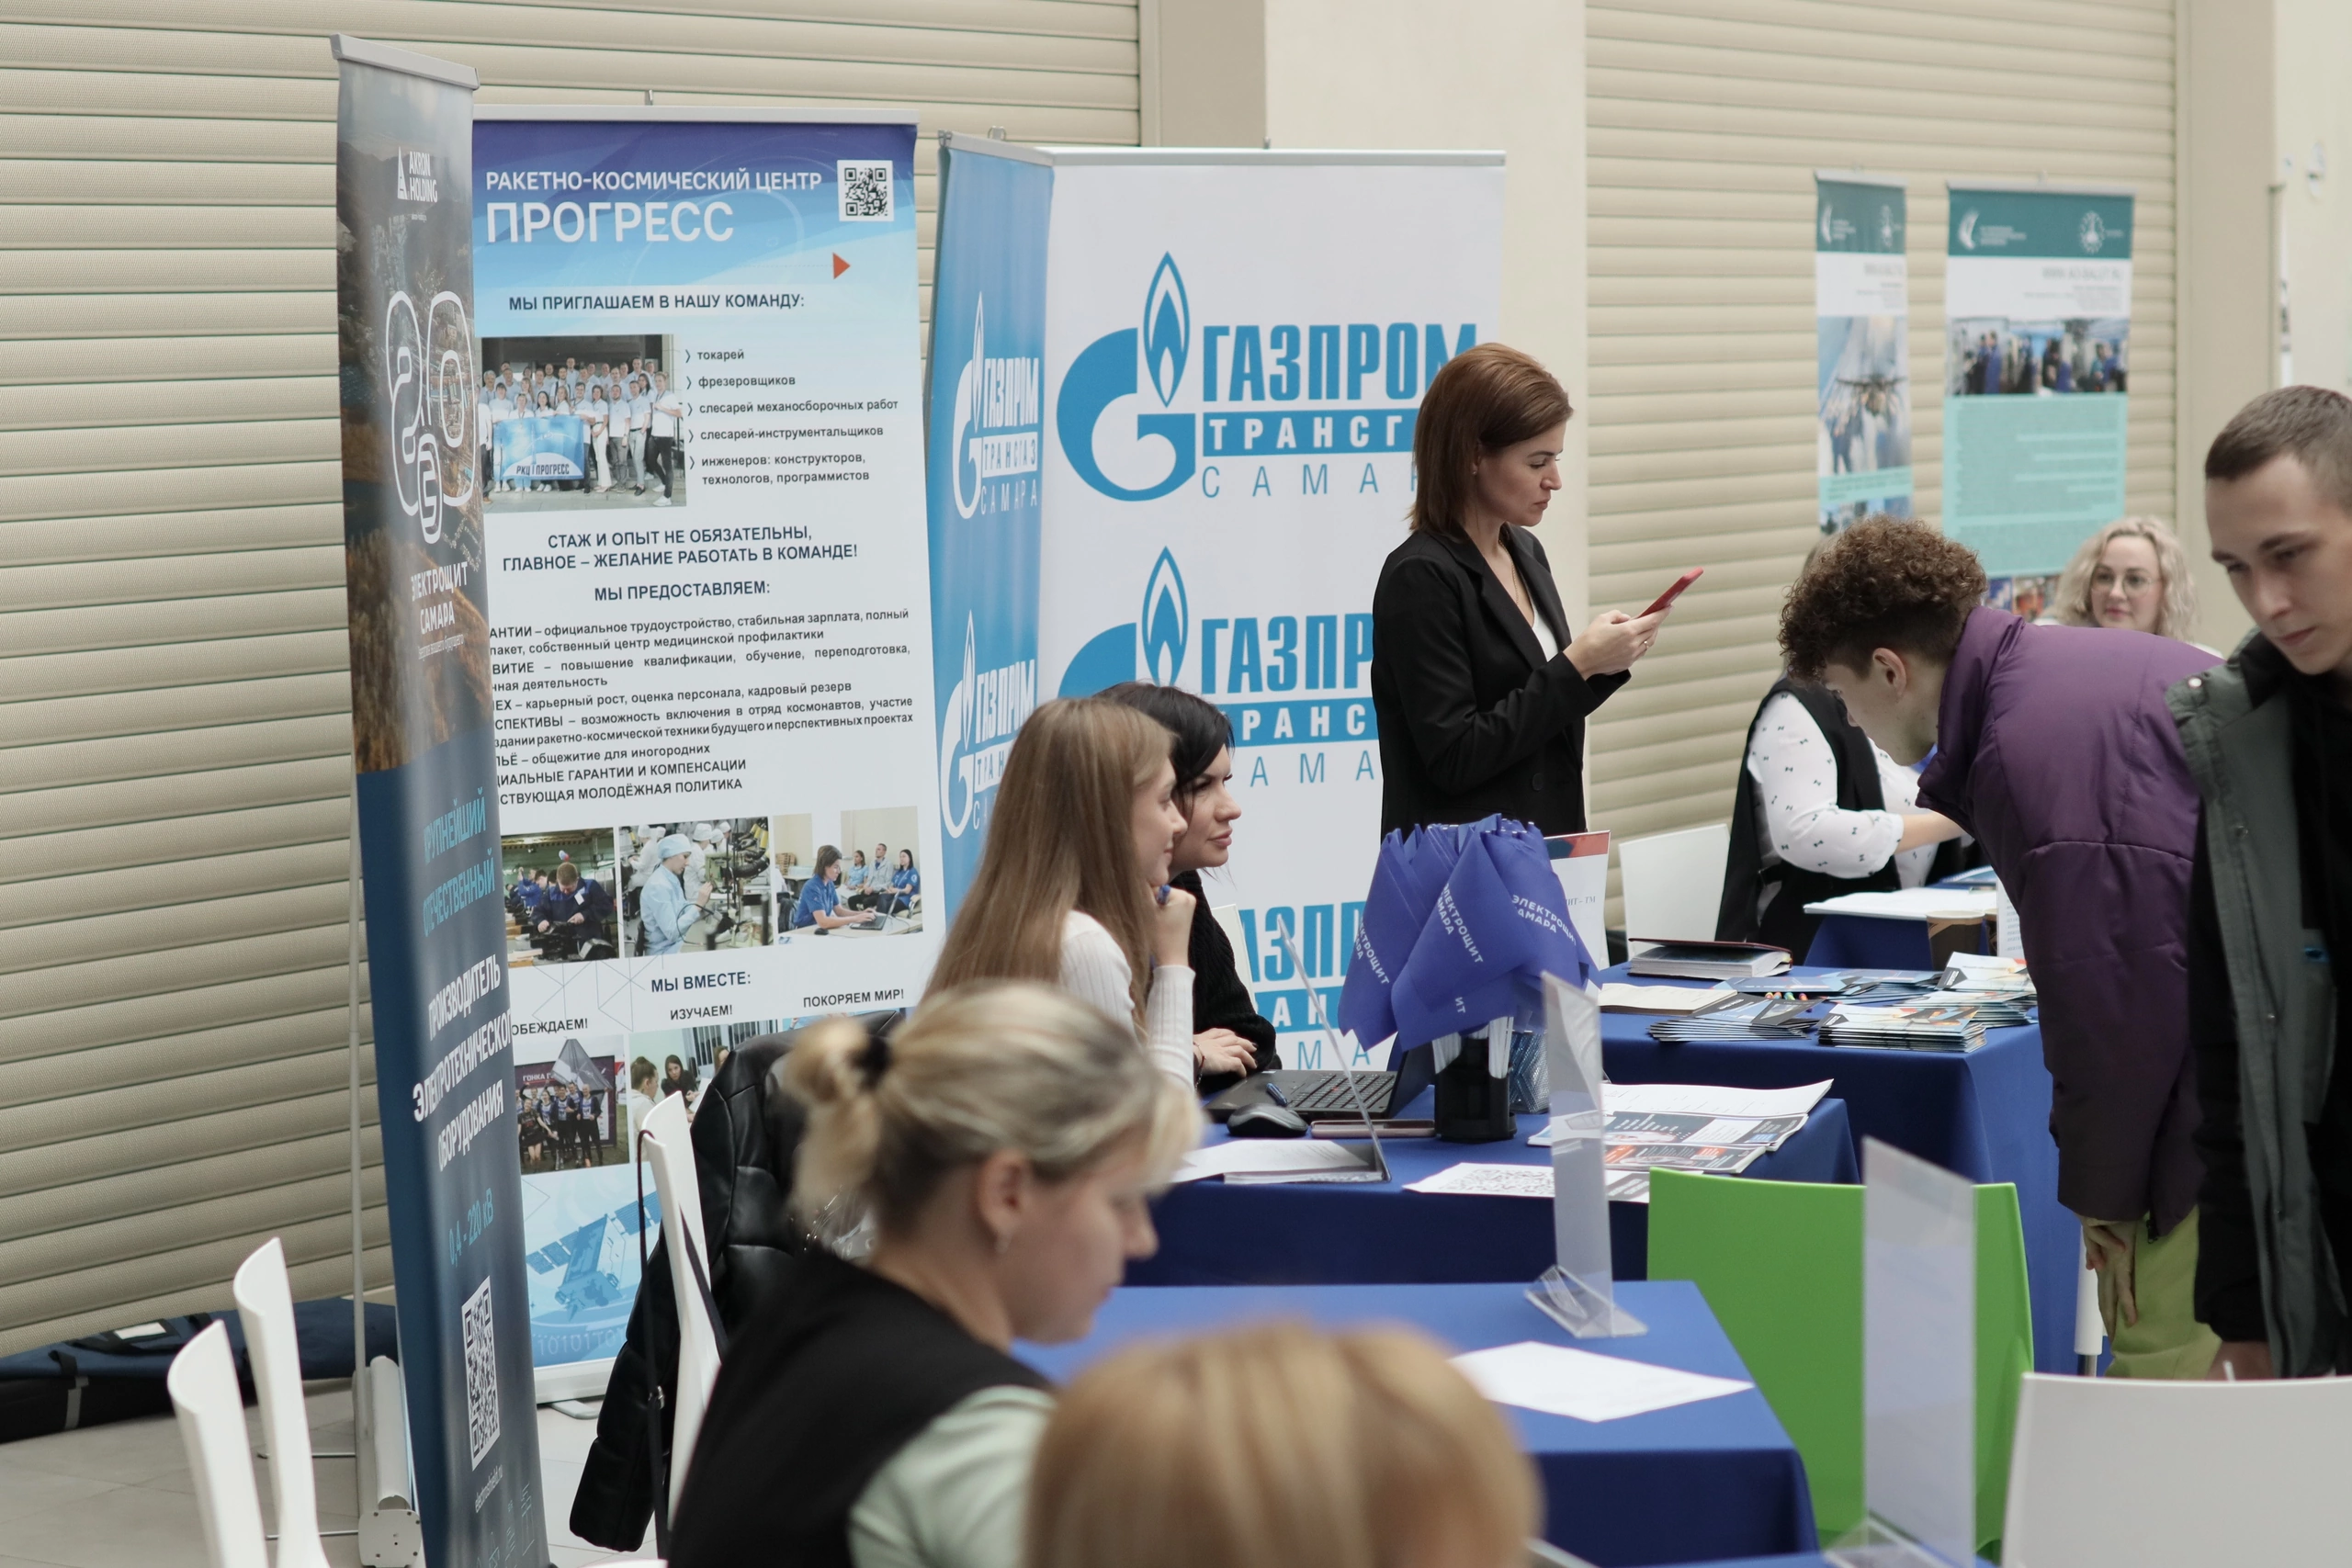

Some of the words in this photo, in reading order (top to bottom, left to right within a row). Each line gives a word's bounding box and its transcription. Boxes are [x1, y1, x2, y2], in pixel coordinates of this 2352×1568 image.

[410, 152, 431, 176] AKRON
[410, 177, 438, 203] HOLDING
[486, 167, 751, 191] РАКЕТНО-КОСМИЧЕСКИЙ
[755, 172, 822, 192] ЦЕНТР
[486, 201, 734, 243] ПРОГРЕСС
[509, 297, 537, 310] МЫ
[542, 296, 655, 310] ПРИГЛАШАЕМ
[660, 296, 670, 309] В
[675, 295, 720, 310] НАШУ
[725, 293, 805, 310] КОМАНДУ:
[697, 349, 745, 362] токарей
[698, 375, 796, 389] фрезеровщиков
[982, 356, 1039, 428] ГАЗПРОМ
[699, 401, 753, 415] слесарей
[757, 399, 864, 413] механосборочных
[867, 399, 899, 412] работ
[700, 427, 884, 443] слесарей-инструментальщиков
[1209, 415, 1402, 450] ТРАНСГ
[702, 456, 772, 469] инженеров:
[775, 453, 865, 467] конструкторов,
[984, 438, 1036, 471] ТРАНСГАЗ
[516, 465, 531, 476] РКЦ
[536, 464, 570, 475] ПРОГРЕСС
[703, 474, 773, 485] технологов,
[776, 471, 870, 485] программистов
[1202, 461, 1415, 499] САМА
[980, 479, 1037, 515] САМАРА
[548, 533, 591, 549] СТАЖ
[596, 533, 607, 547] И
[612, 531, 660, 547] ОПЫТ
[665, 530, 685, 545] НЕ
[689, 525, 813, 545] ОБЯЗАТЕЛЬНЫ,
[503, 555, 576, 571] ГЛАВНОЕ
[594, 552, 673, 569] ЖЕЛАНИЕ
[678, 548, 759, 565] РАБОТАТЬ
[763, 547, 774, 560] В
[777, 544, 858, 562] КОМАНДЕ!
[594, 587, 623, 602] МЫ
[628, 581, 771, 601] ПРЕДОСТАВЛЯЕМ:
[420, 601, 455, 635] САМАРА
[489, 626, 532, 639] АНТИИ
[544, 624, 628, 638] официальное
[630, 616, 735, 635] трудоустройство,
[737, 614, 805, 626] стабильная
[808, 610, 864, 625] зарплата,
[865, 608, 909, 622] полный
[490, 645, 526, 656] пакет,
[528, 637, 610, 653] собственный
[614, 637, 650, 651] центр
[654, 632, 734, 648] медицинской
[738, 629, 824, 645] профилактики
[1201, 612, 1374, 695] ГАЗПР
[492, 662, 535, 675] ВИТИЕ
[560, 659, 634, 671] повышение
[644, 653, 736, 668] квалификации,
[745, 649, 805, 663] обучение,
[814, 644, 910, 660] переподготовка,
[493, 699, 512, 711] ЕХ
[526, 694, 594, 711] карьерный
[597, 695, 628, 708] рост,
[631, 692, 673, 705] оценка
[677, 686, 745, 702] персонала,
[748, 682, 807, 698] кадровый
[810, 682, 852, 695] резерв
[522, 677, 608, 692] деятельность
[494, 716, 563, 730] СПЕКТИВЫ
[581, 711, 661, 726] возможность
[666, 706, 730, 721] включения
[736, 706, 743, 716] в
[748, 704, 782, 717] отряд
[786, 698, 865, 714] космонавтов,
[869, 695, 913, 711] участие
[975, 659, 1035, 744] ГАЗПРОМ
[494, 737, 536, 750] здании
[537, 727, 662, 747] ракетно-космической
[664, 725, 709, 739] техники
[711, 720, 765, 737] будущего
[766, 721, 774, 730] и
[775, 716, 863, 732] перспективных
[864, 712, 914, 728] проектах
[1242, 704, 1366, 741] РАНС
[532, 750, 601, 765] общежитие
[604, 750, 628, 761] для
[630, 745, 711, 760] иногородних
[497, 771, 564, 787] ИАЛЬНЫЕ
[568, 766, 634, 781] ГАРАНТИИ
[638, 765, 647, 776] И
[650, 759, 746, 775] КОМПЕНСАЦИИ
[1250, 750, 1375, 788] АМА
[500, 789, 574, 805] СТВУЮЩАЯ
[578, 782, 672, 800] МОЛОДЁЖНАЯ
[675, 778, 743, 794] ПОЛИТИКА
[1517, 908, 1556, 933] АМАРА
[650, 977, 679, 993] МЫ
[684, 971, 752, 992] ВМЕСТЕ:
[428, 953, 501, 1042] ПРОИЗВОДИТЕЛЬ
[802, 991, 871, 1009] ПОКОРЯЕМ
[875, 988, 905, 1005] МИР!
[670, 1004, 733, 1021] ИЗУЧАЕМ!
[512, 1018, 588, 1036] ОБЕЖДАЕМ!
[413, 1008, 513, 1122] ЭЛЕКТРОТЕХНИЧЕСКОГ
[437, 1078, 503, 1172] ОБОРУДОВАНИЯ
[468, 1200, 481, 1246] 220
